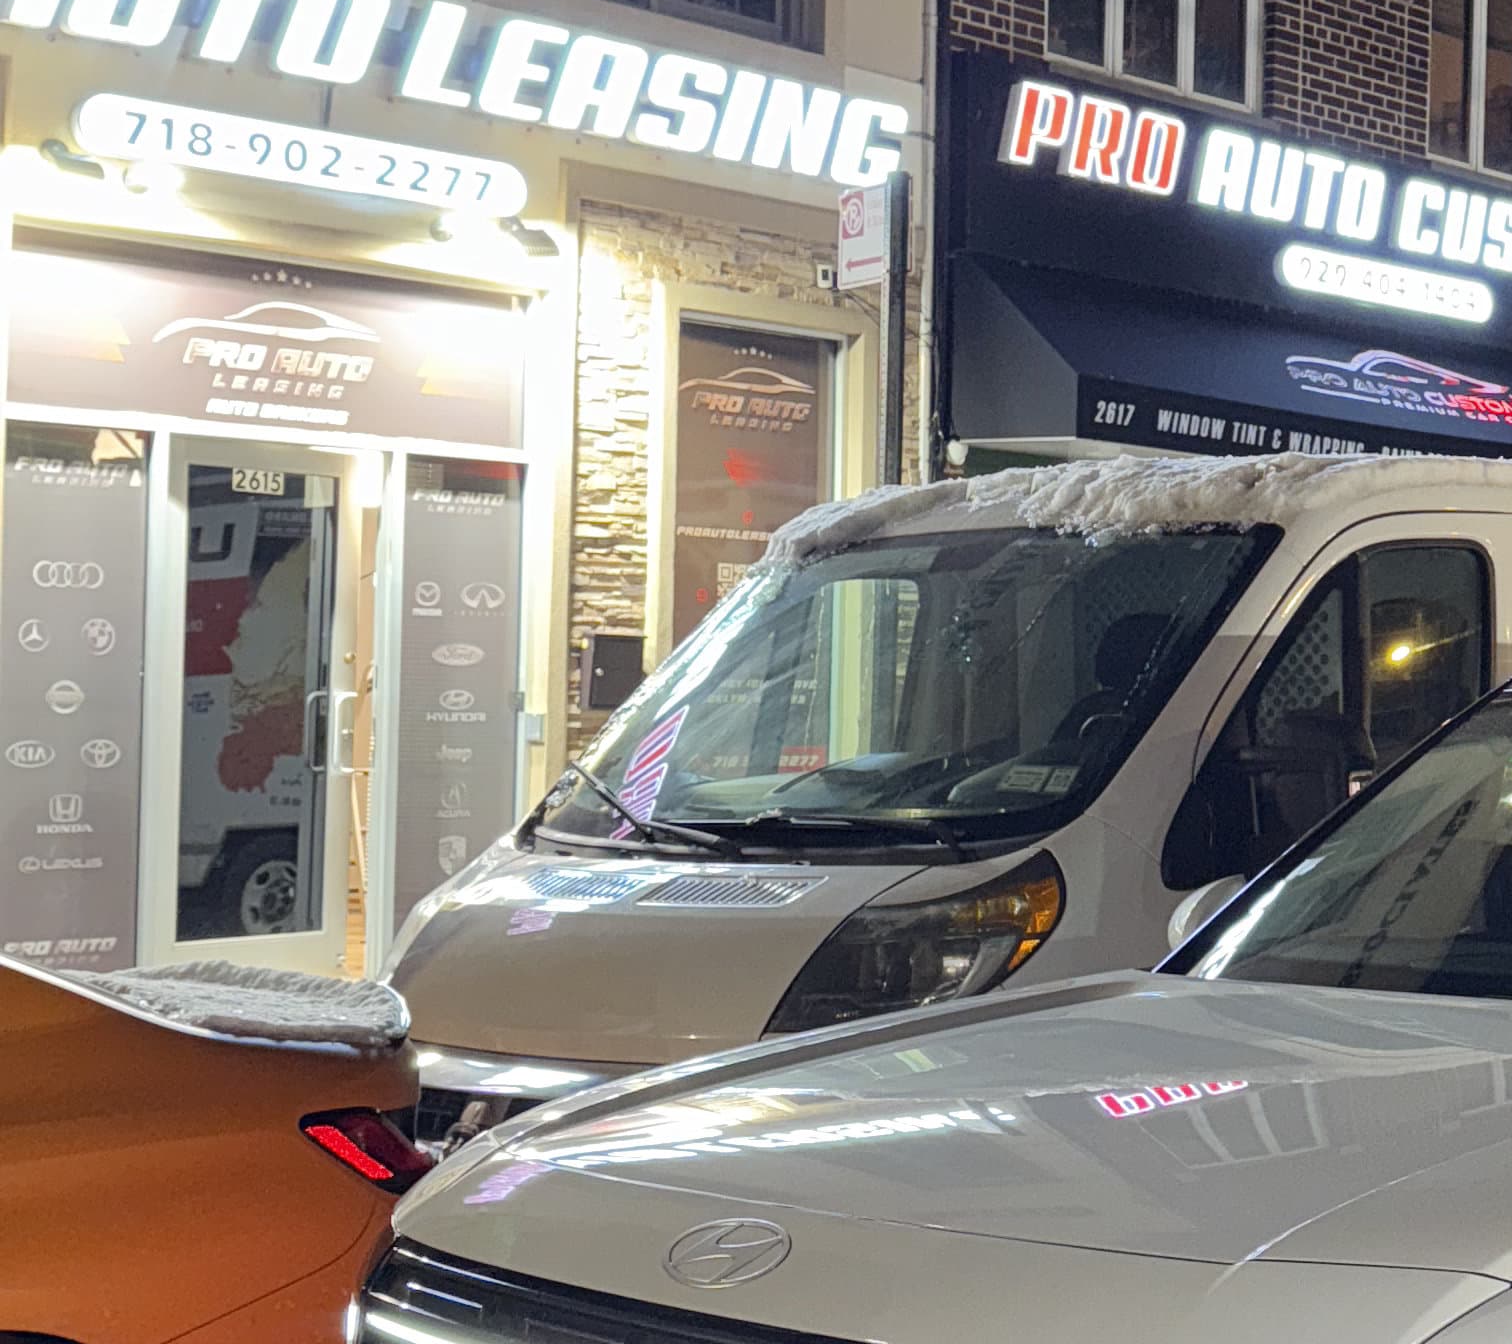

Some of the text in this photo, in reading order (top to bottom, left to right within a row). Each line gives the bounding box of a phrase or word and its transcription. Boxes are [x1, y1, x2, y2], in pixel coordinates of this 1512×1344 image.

[401, 1, 910, 188] LEASING
[125, 111, 491, 201] 718-902-2277
[1004, 80, 1186, 196] PRO
[1197, 128, 1386, 243] AUTO
[183, 337, 374, 382] PRO AUTO
[212, 373, 344, 399] LEASING
[692, 391, 812, 424] PRO AUTO
[1094, 400, 1135, 426] 2617
[1157, 408, 1226, 441] WINDOW
[1232, 421, 1266, 449] TINT
[235, 469, 281, 493] 2615
[426, 712, 486, 722] HYUNDAI
[14, 747, 47, 761] KIA
[36, 823, 93, 833] HONDA
